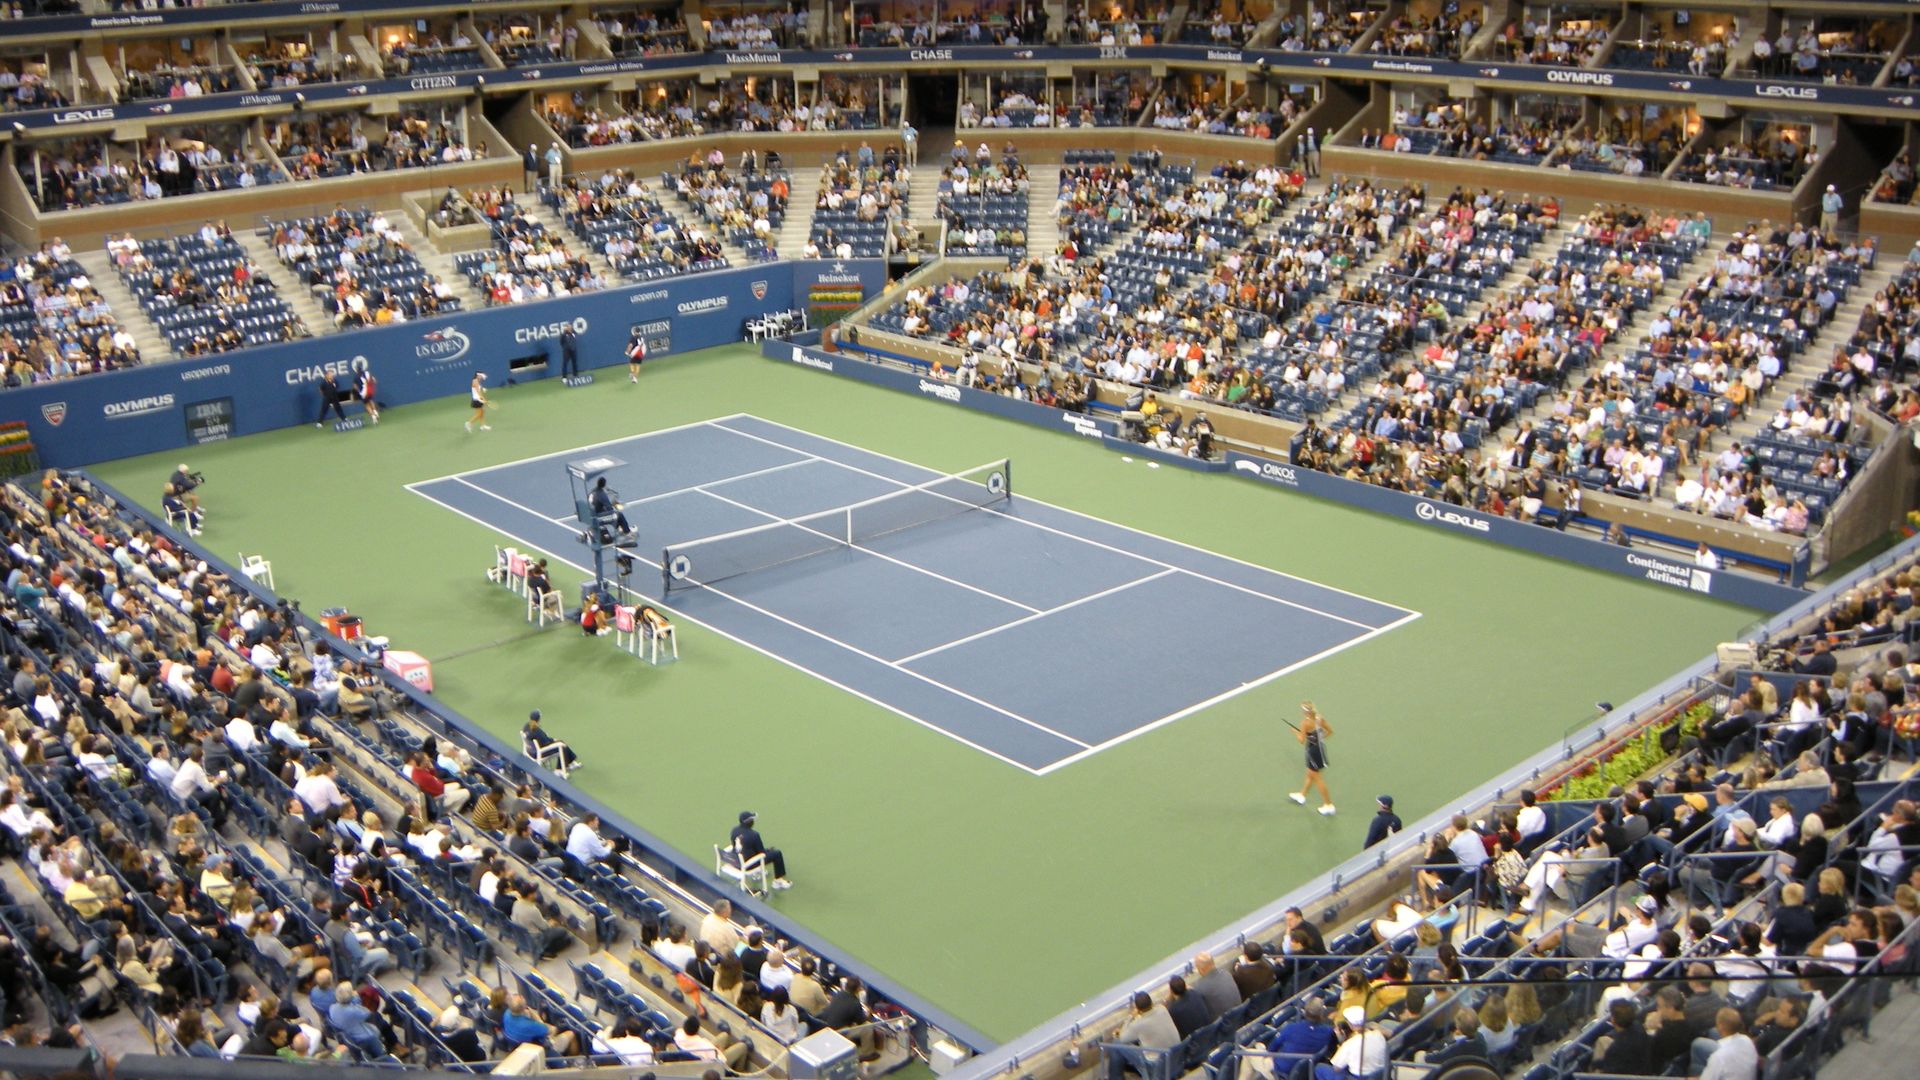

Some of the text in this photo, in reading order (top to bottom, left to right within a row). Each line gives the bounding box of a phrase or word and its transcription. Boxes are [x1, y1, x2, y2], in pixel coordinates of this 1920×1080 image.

[726, 52, 780, 63] MassMutual
[910, 49, 953, 60] CHASE
[1100, 47, 1127, 58] IBM
[1207, 50, 1242, 62] Heineken
[411, 75, 457, 89] CITIZEN
[1547, 70, 1613, 86] OLYMPUS
[1756, 84, 1818, 99] LEXUS
[53, 108, 115, 124] LEXUS
[818, 273, 860, 283] Heineken
[677, 295, 728, 313] OLYMPUS
[415, 338, 462, 357] US OPEN
[180, 364, 231, 382] usopen.org
[285, 359, 349, 385] CHASE
[103, 393, 175, 416] OLYMPUS
[195, 401, 223, 418] IBM
[1262, 463, 1296, 480] OIKOS
[1435, 508, 1490, 532] LEXUS
[1626, 553, 1691, 577] Continental
[1645, 568, 1689, 588] Airlines
